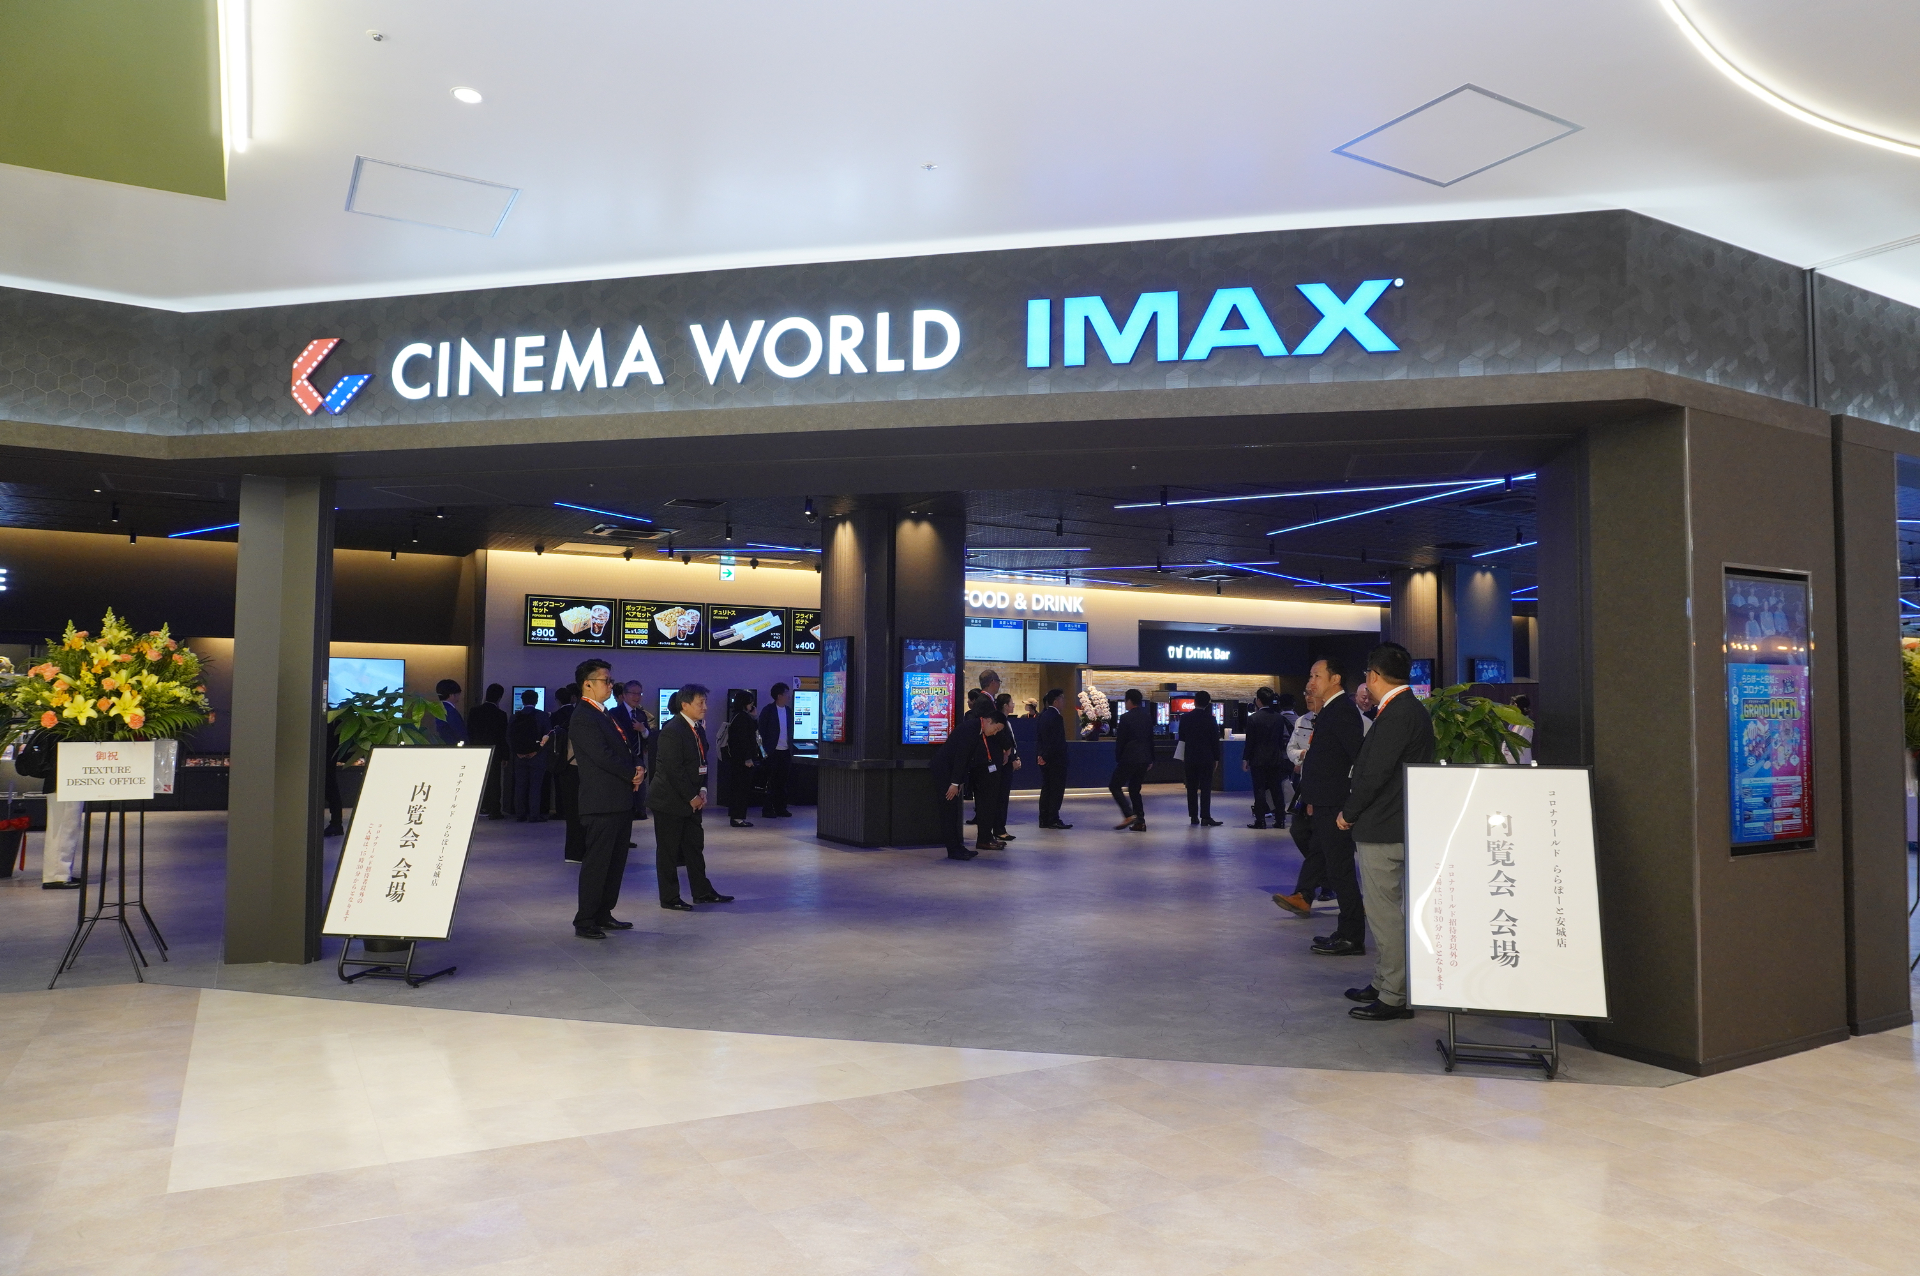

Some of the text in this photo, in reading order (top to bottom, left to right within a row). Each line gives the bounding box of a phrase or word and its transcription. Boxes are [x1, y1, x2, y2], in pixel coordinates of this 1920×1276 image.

[391, 309, 961, 400] CINEMA WORLD
[532, 600, 566, 608] ポップコーン
[625, 604, 657, 612] ポップコーン
[1014, 592, 1027, 610] &
[1032, 593, 1084, 613] DRINK
[531, 628, 555, 637] ¥900
[761, 640, 782, 649] ¥450
[795, 641, 815, 650] ¥400
[1185, 647, 1231, 660] Drink Bar
[1744, 699, 1797, 718] GRAND OPEN
[96, 751, 119, 761] 御祝
[82, 766, 132, 775] TEXTURE
[66, 776, 146, 787] DESING OFFICE
[448, 764, 467, 818] コロナワールド
[385, 781, 432, 904] 内覧会 会場
[1548, 789, 1568, 949] コロナワールド ららぽーと安城店
[1485, 810, 1521, 969] 内覧会 会場
[1448, 863, 1459, 968] コロナワールド招待者以外の
